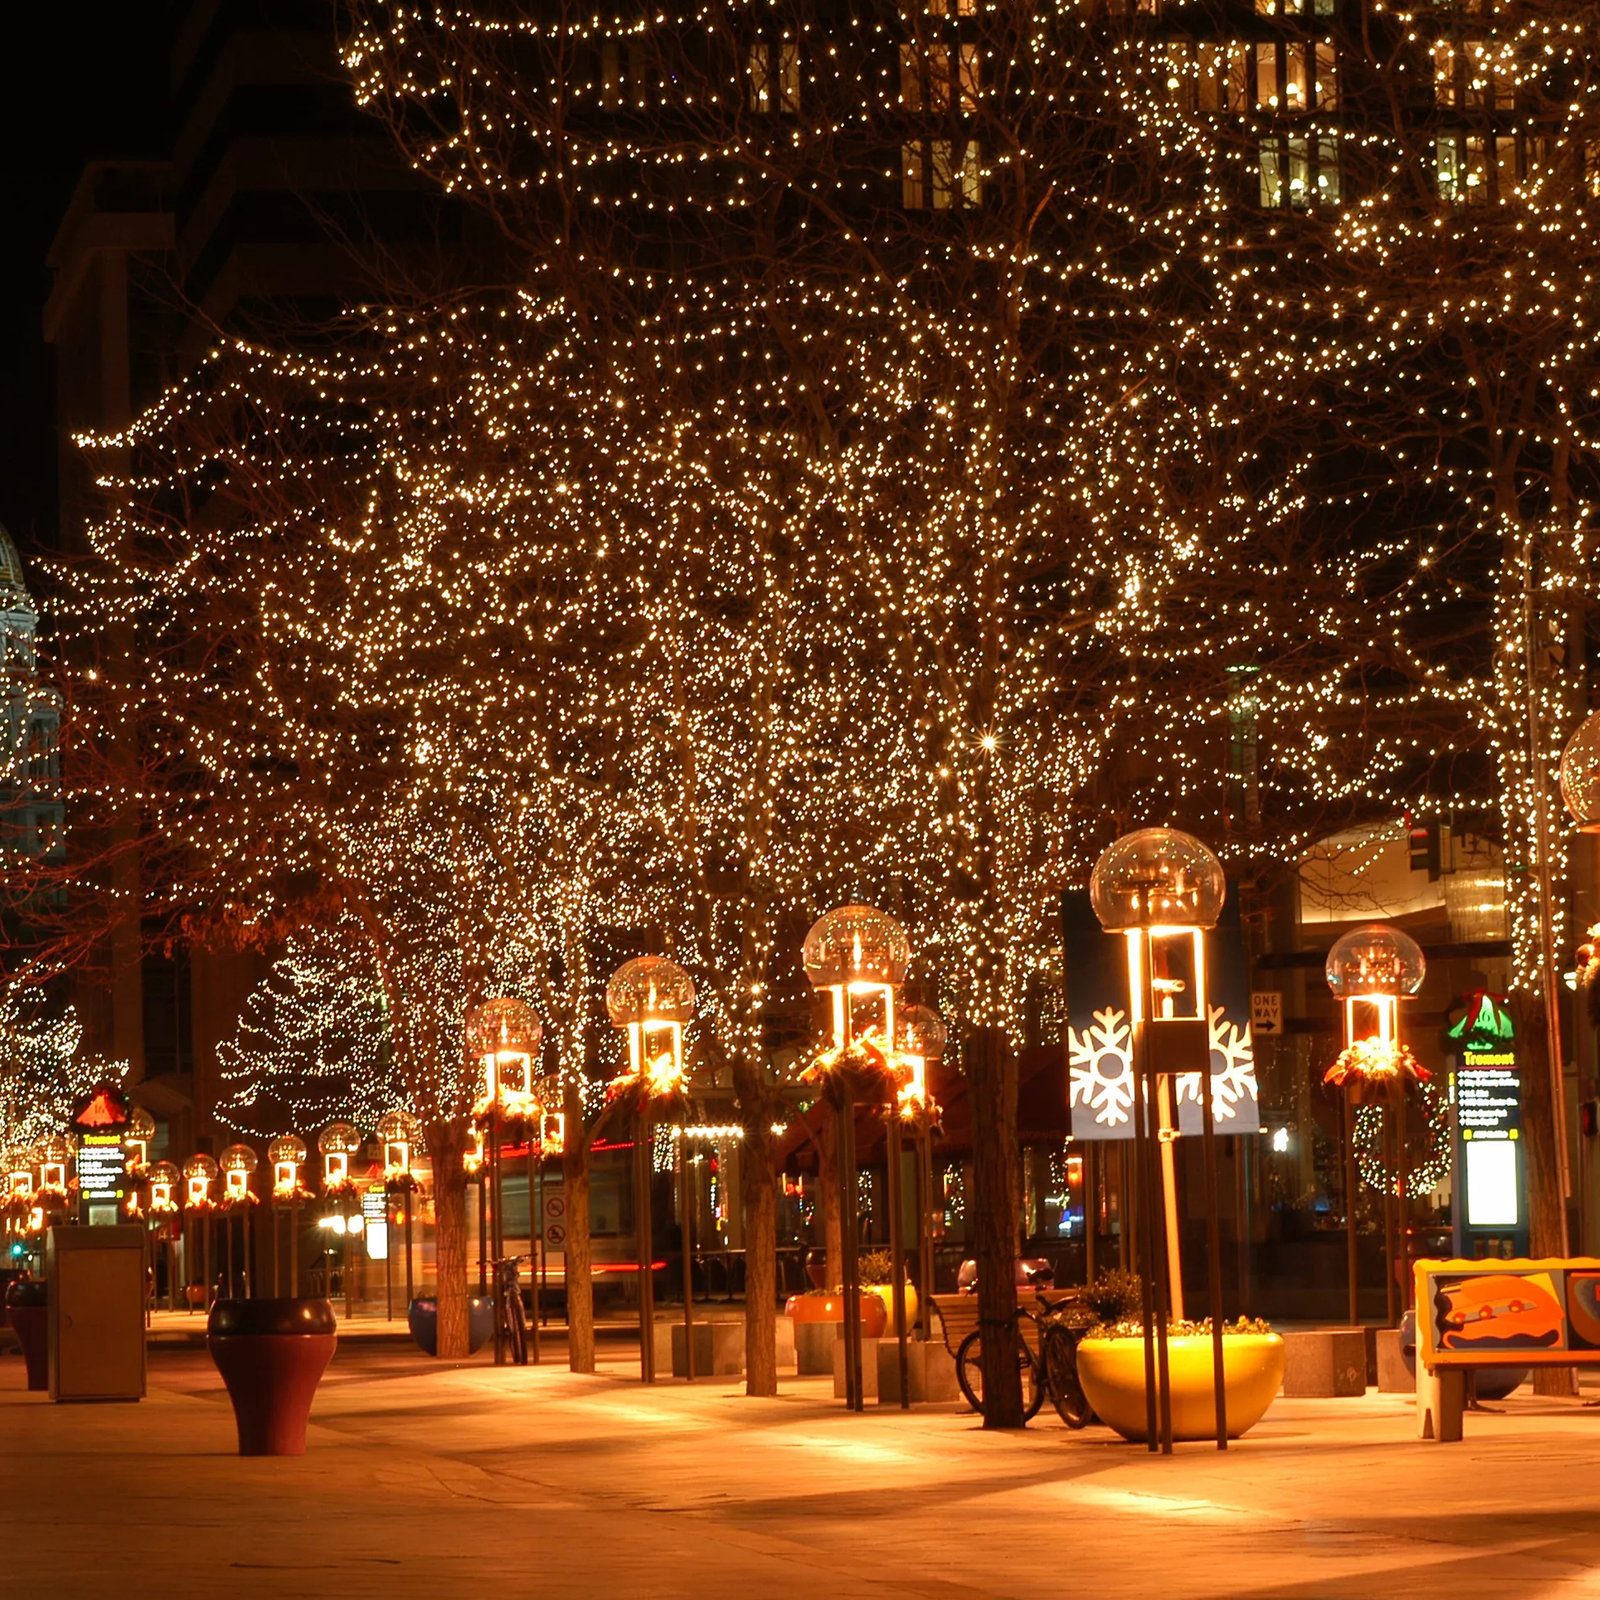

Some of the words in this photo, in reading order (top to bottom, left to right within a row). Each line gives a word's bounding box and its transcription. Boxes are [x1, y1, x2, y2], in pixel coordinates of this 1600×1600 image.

[1254, 995, 1277, 1006] ONE
[1254, 1008, 1278, 1018] WAY
[1463, 1051, 1515, 1066] Tremont
